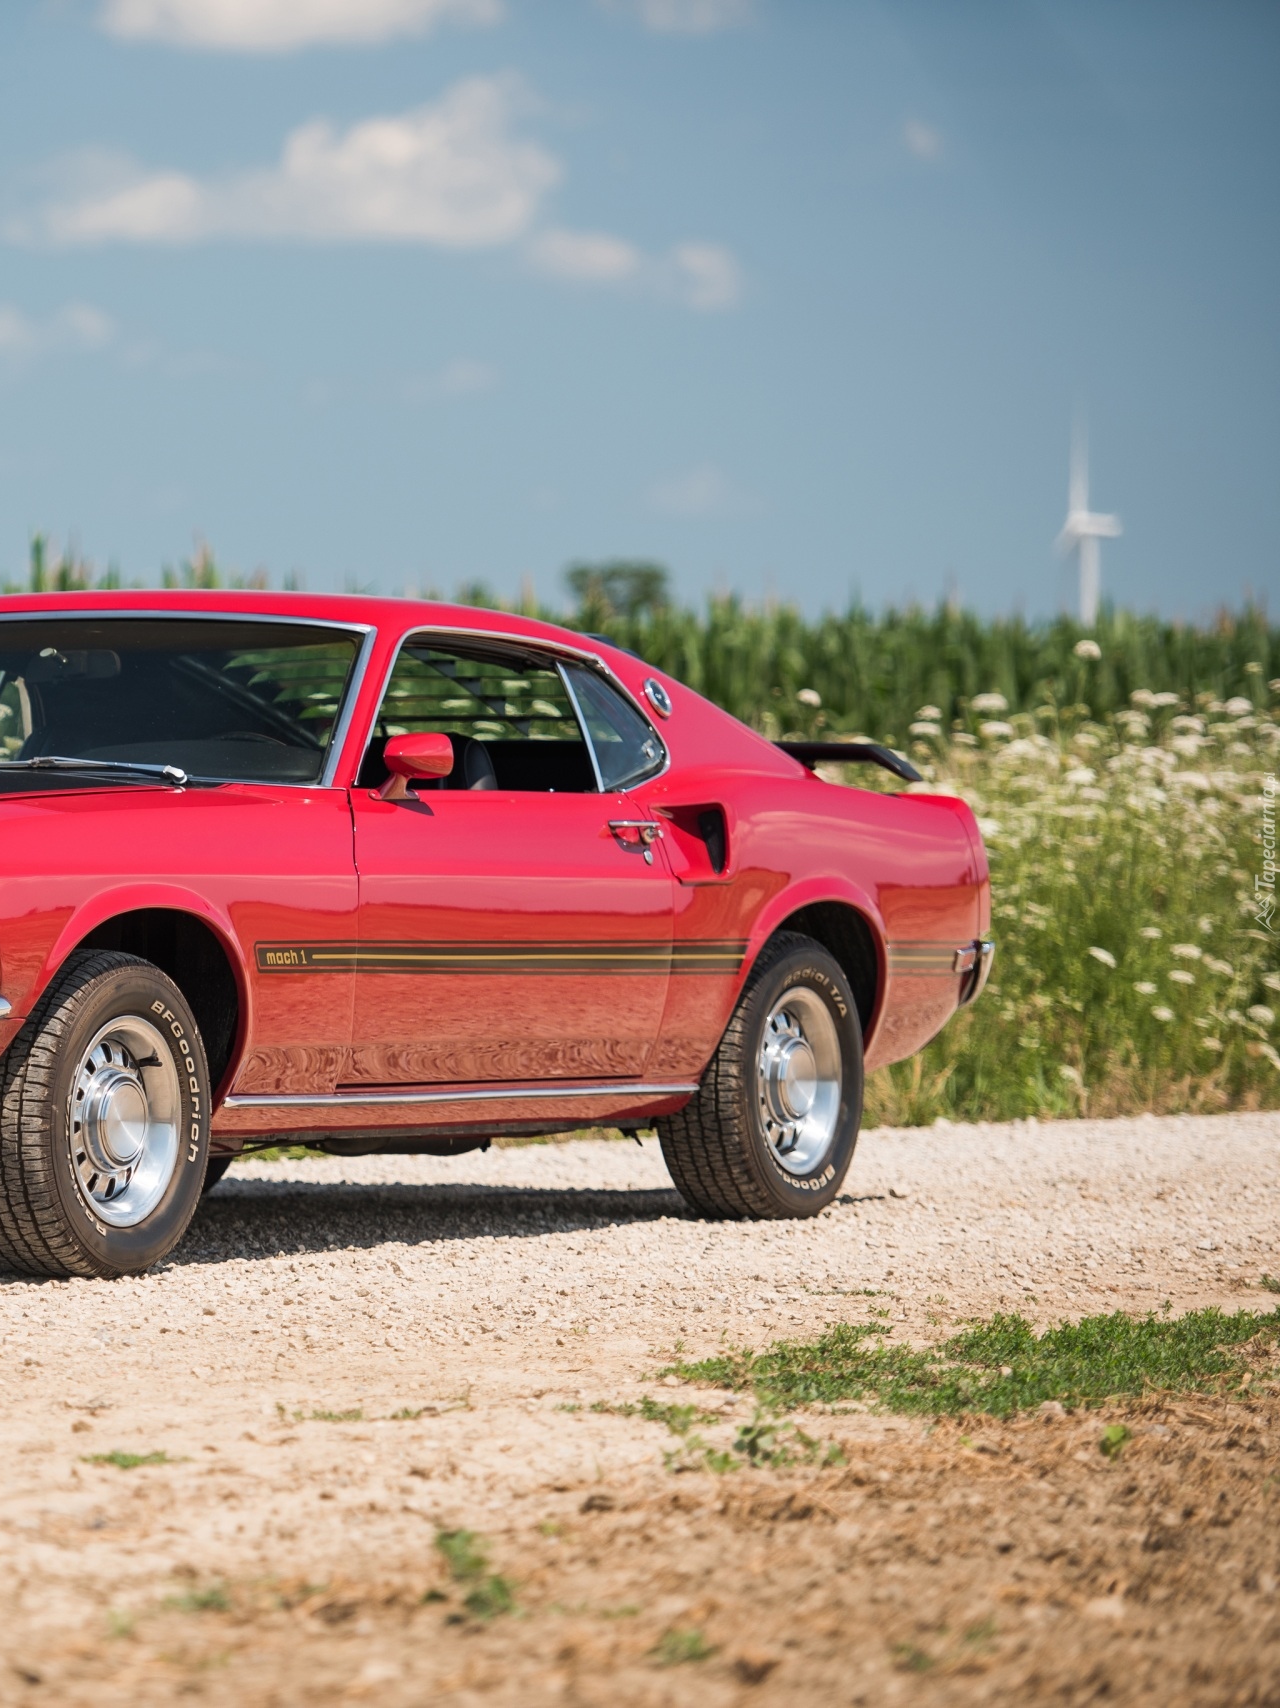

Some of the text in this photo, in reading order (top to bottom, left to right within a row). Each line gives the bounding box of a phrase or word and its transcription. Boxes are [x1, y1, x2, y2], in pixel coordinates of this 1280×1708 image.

[266, 949, 308, 965] mach 1
[150, 1000, 202, 1163] BFGoodrich
